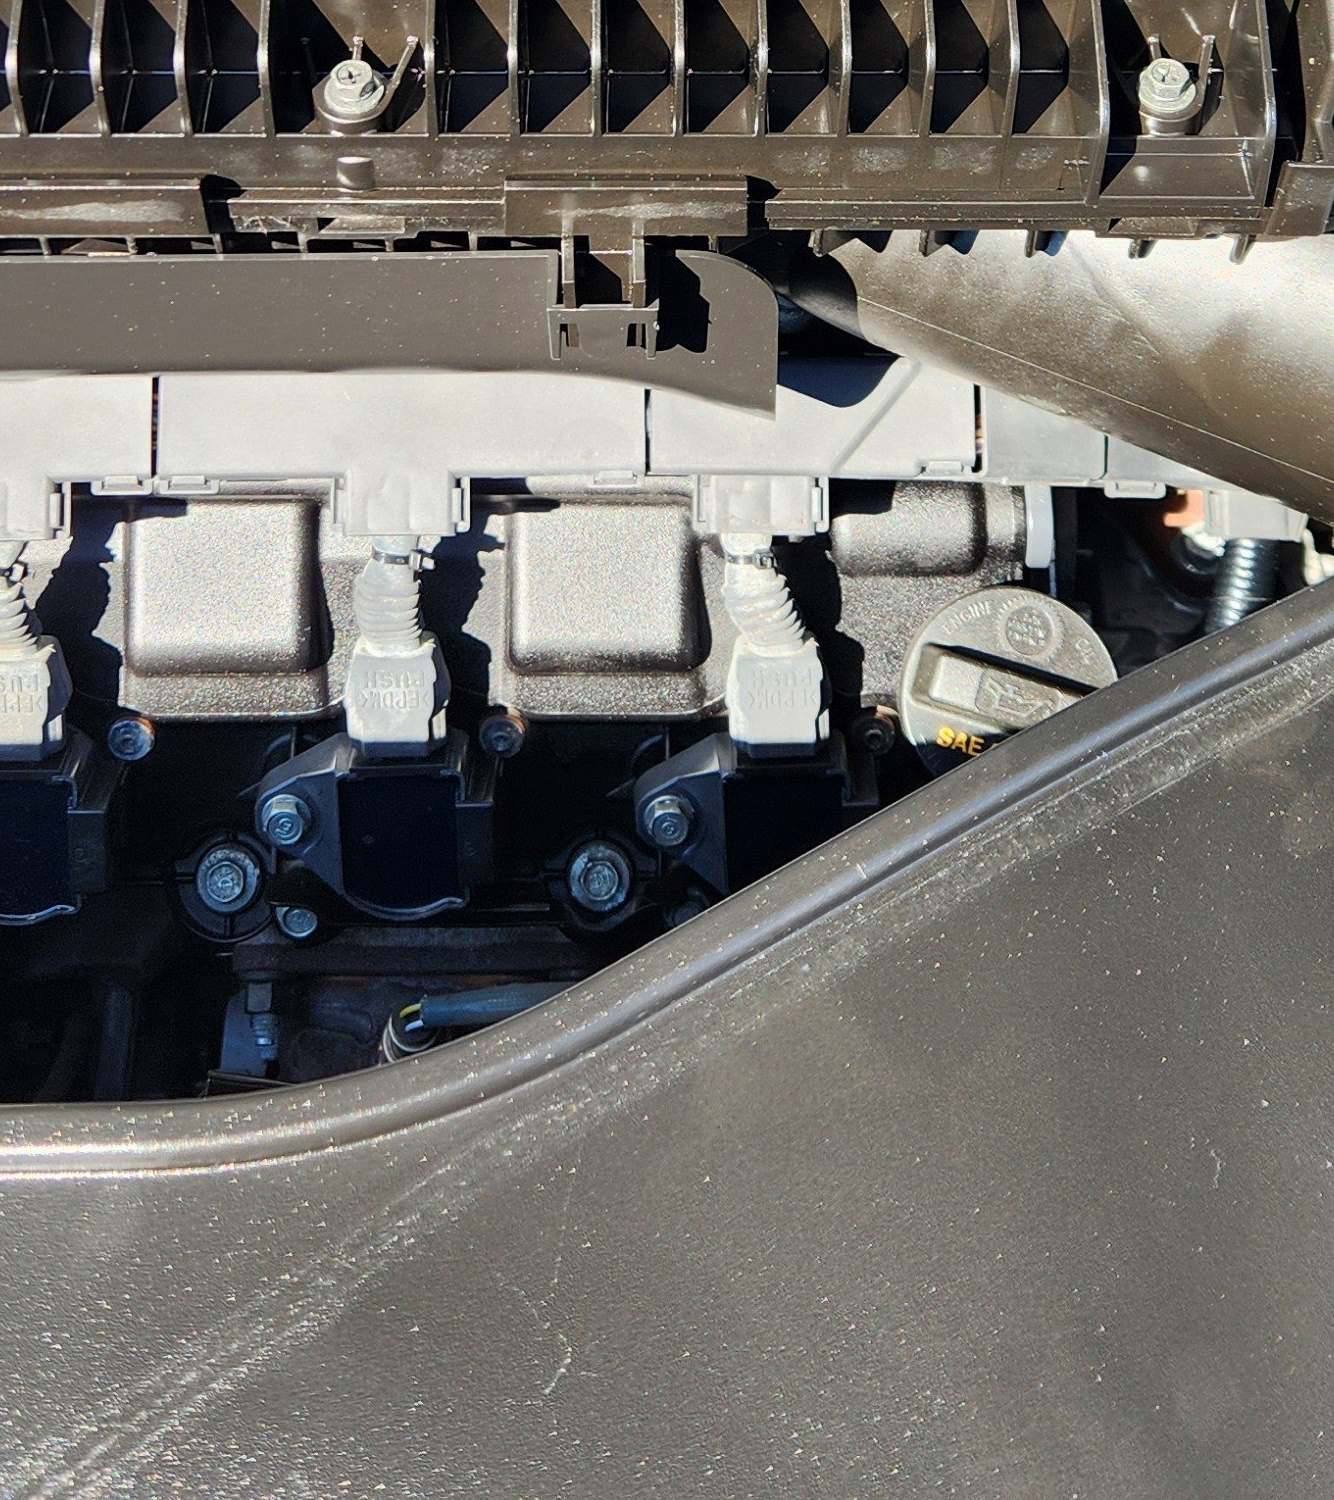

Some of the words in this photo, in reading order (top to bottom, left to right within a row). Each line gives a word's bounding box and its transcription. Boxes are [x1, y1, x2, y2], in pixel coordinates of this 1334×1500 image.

[940, 598, 996, 636] ENGINE
[363, 668, 426, 689] PUSH
[936, 726, 986, 757] SAE
